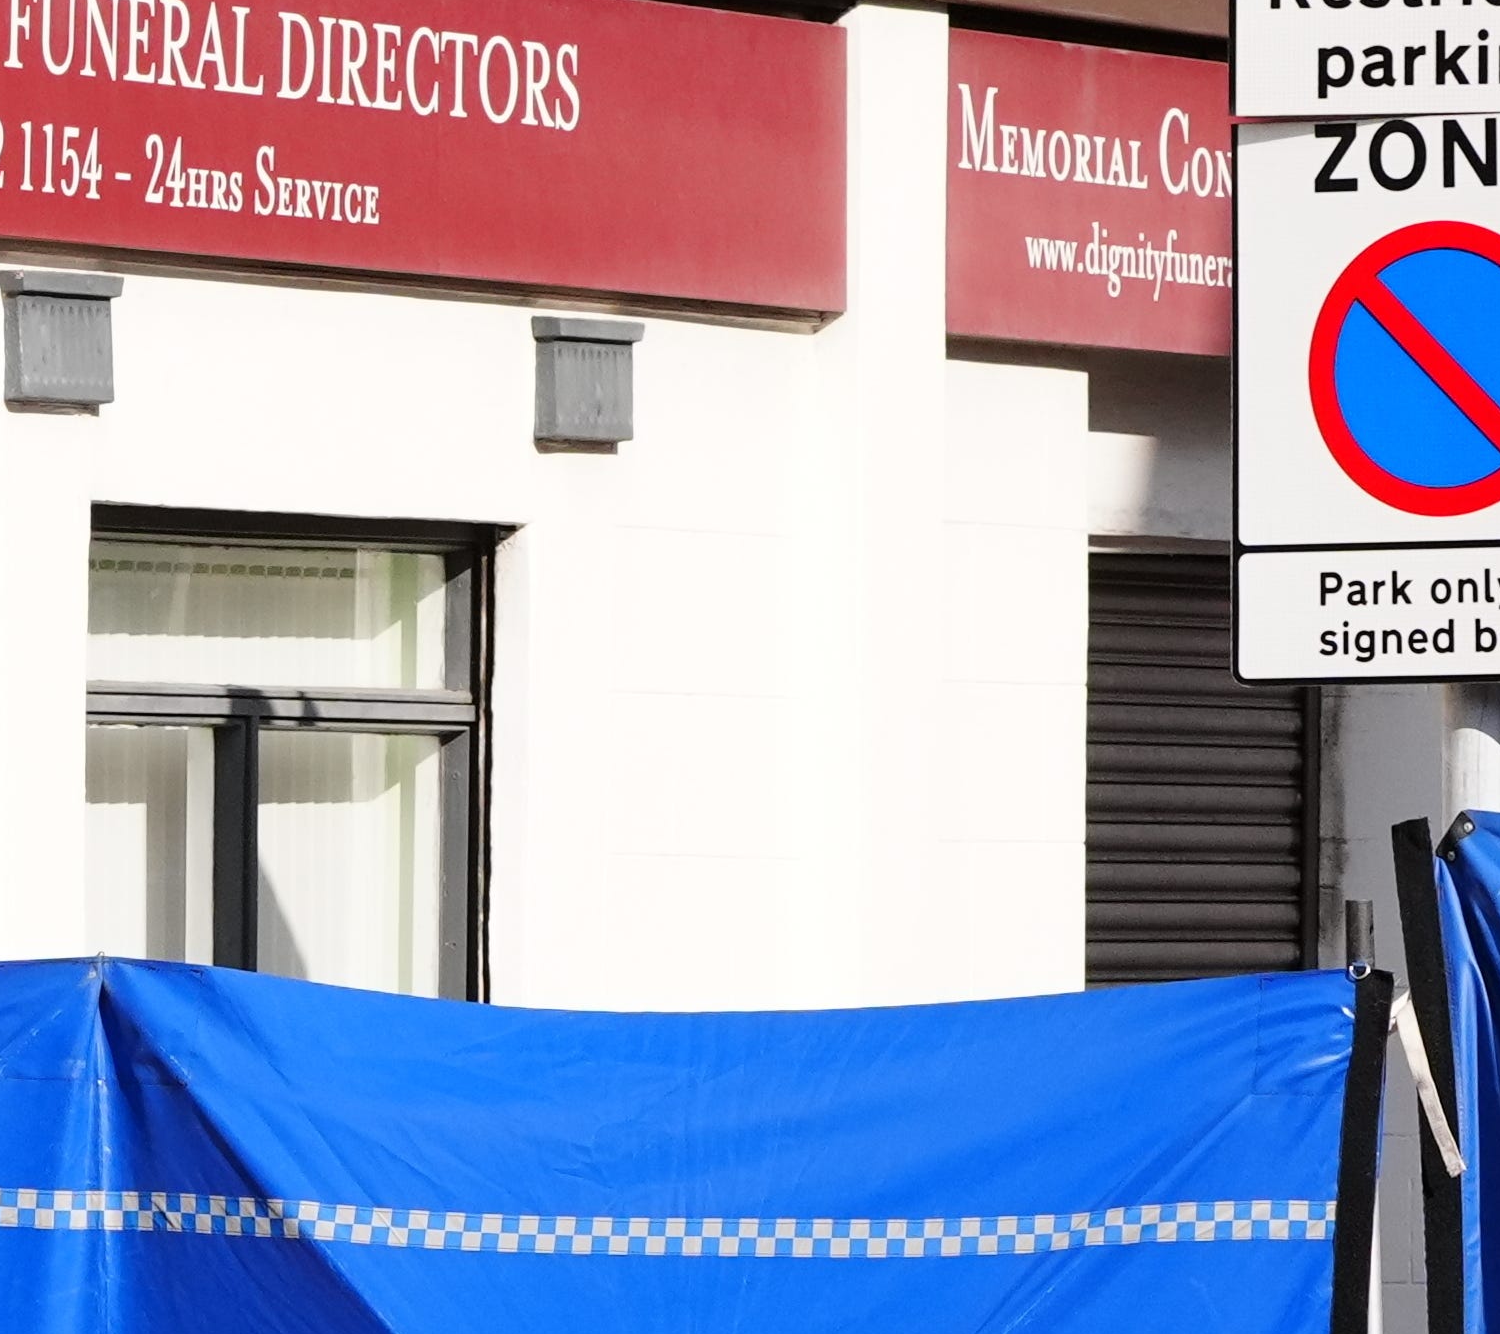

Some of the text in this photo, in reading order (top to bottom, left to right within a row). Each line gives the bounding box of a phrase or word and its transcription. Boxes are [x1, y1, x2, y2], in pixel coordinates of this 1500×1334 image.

[276, 11, 581, 131] DIRECTORS
[20, 121, 102, 200] 1154
[1319, 570, 1413, 606] Park
[1319, 619, 1455, 662] signed
